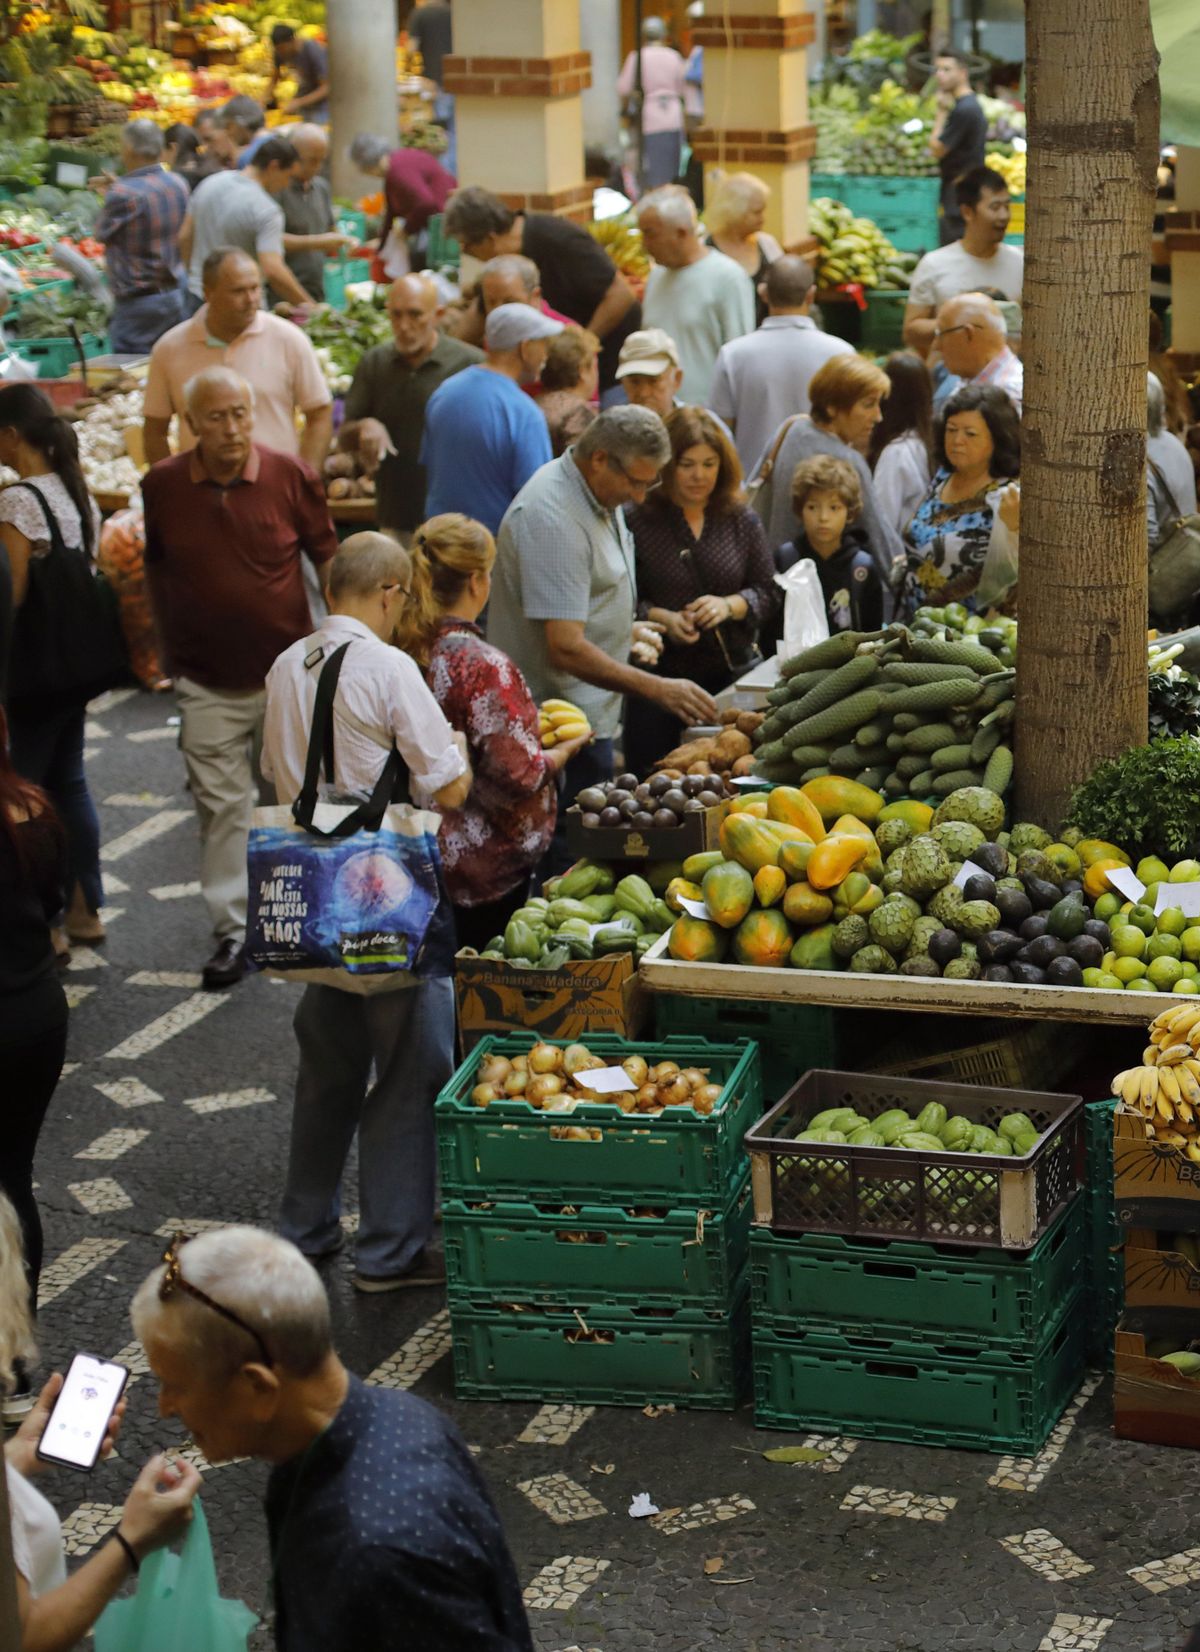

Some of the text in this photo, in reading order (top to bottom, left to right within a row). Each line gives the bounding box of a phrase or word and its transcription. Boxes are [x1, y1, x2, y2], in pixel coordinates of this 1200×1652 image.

[271, 901, 308, 918] NOSSAS
[263, 916, 302, 944] MÃOS
[483, 972, 533, 986] Banana
[545, 974, 600, 987] Madeira
